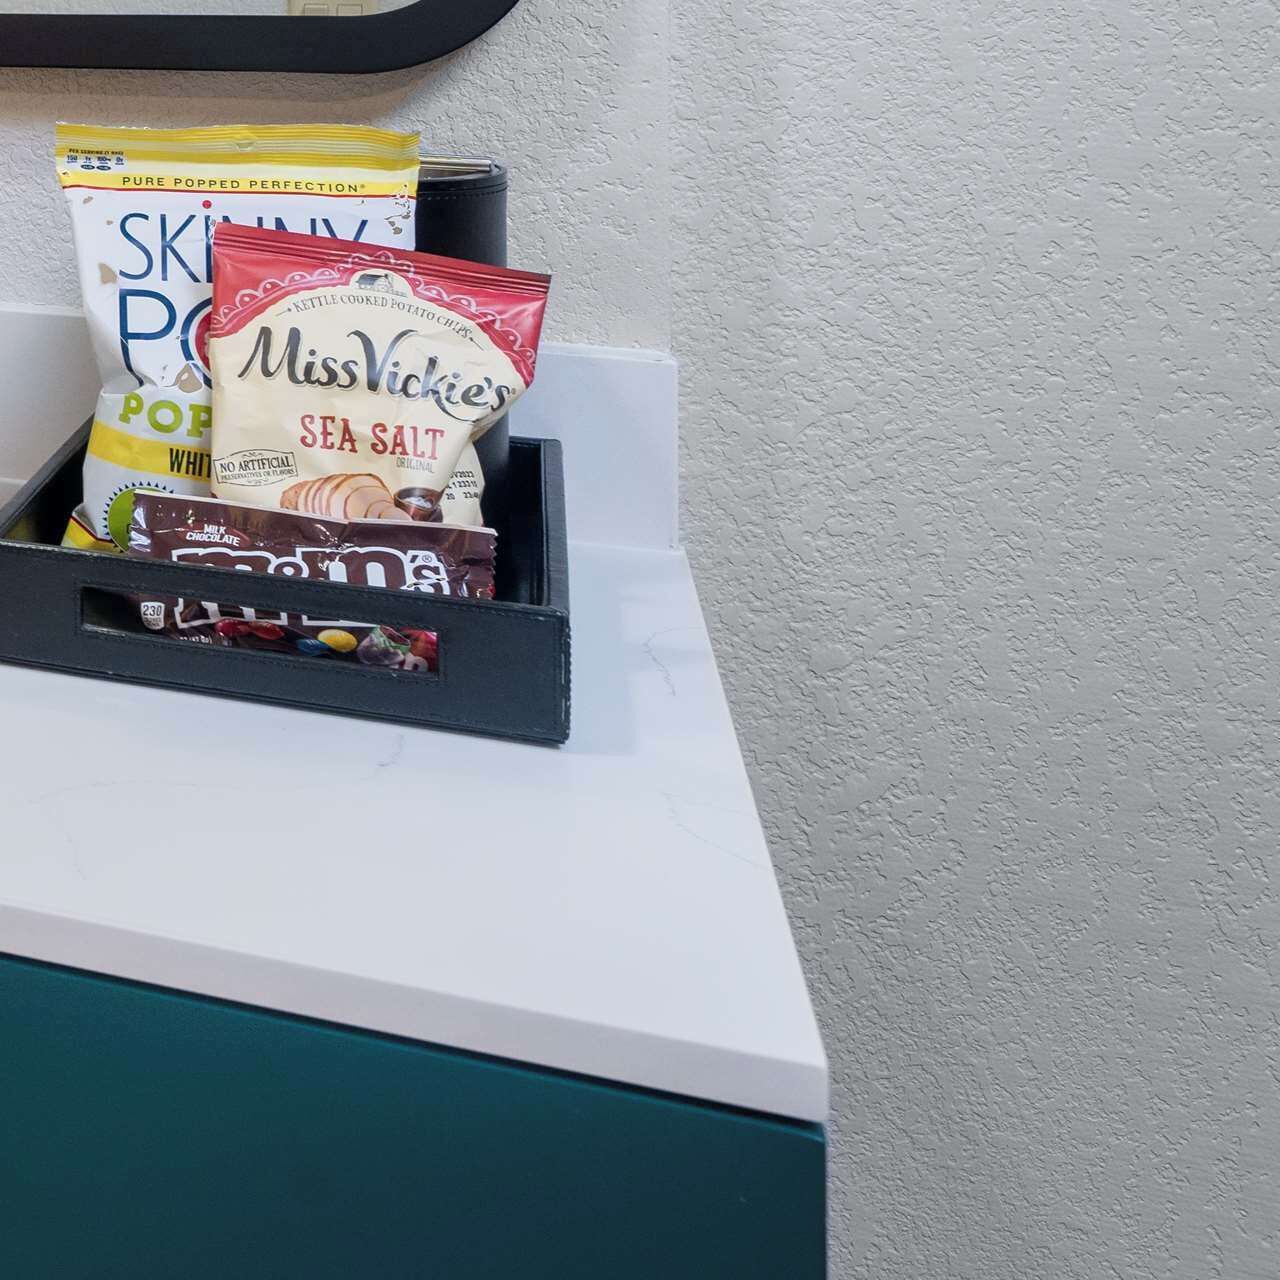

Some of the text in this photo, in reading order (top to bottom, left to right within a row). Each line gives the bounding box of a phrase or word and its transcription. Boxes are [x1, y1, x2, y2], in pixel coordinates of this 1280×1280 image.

[122, 176, 359, 193] PURE POPPED PERFECTION
[292, 294, 474, 339] KETTLE COOKED POTATO CHIPS
[238, 326, 511, 422] Miss Vickie's
[300, 414, 446, 460] SEA SALT
[220, 455, 294, 473] NO ARTIFICIAL
[396, 457, 435, 474] ORIGINAL
[203, 523, 226, 534] MILK
[186, 531, 241, 547] CHOCOLATE
[143, 604, 162, 616] 230
